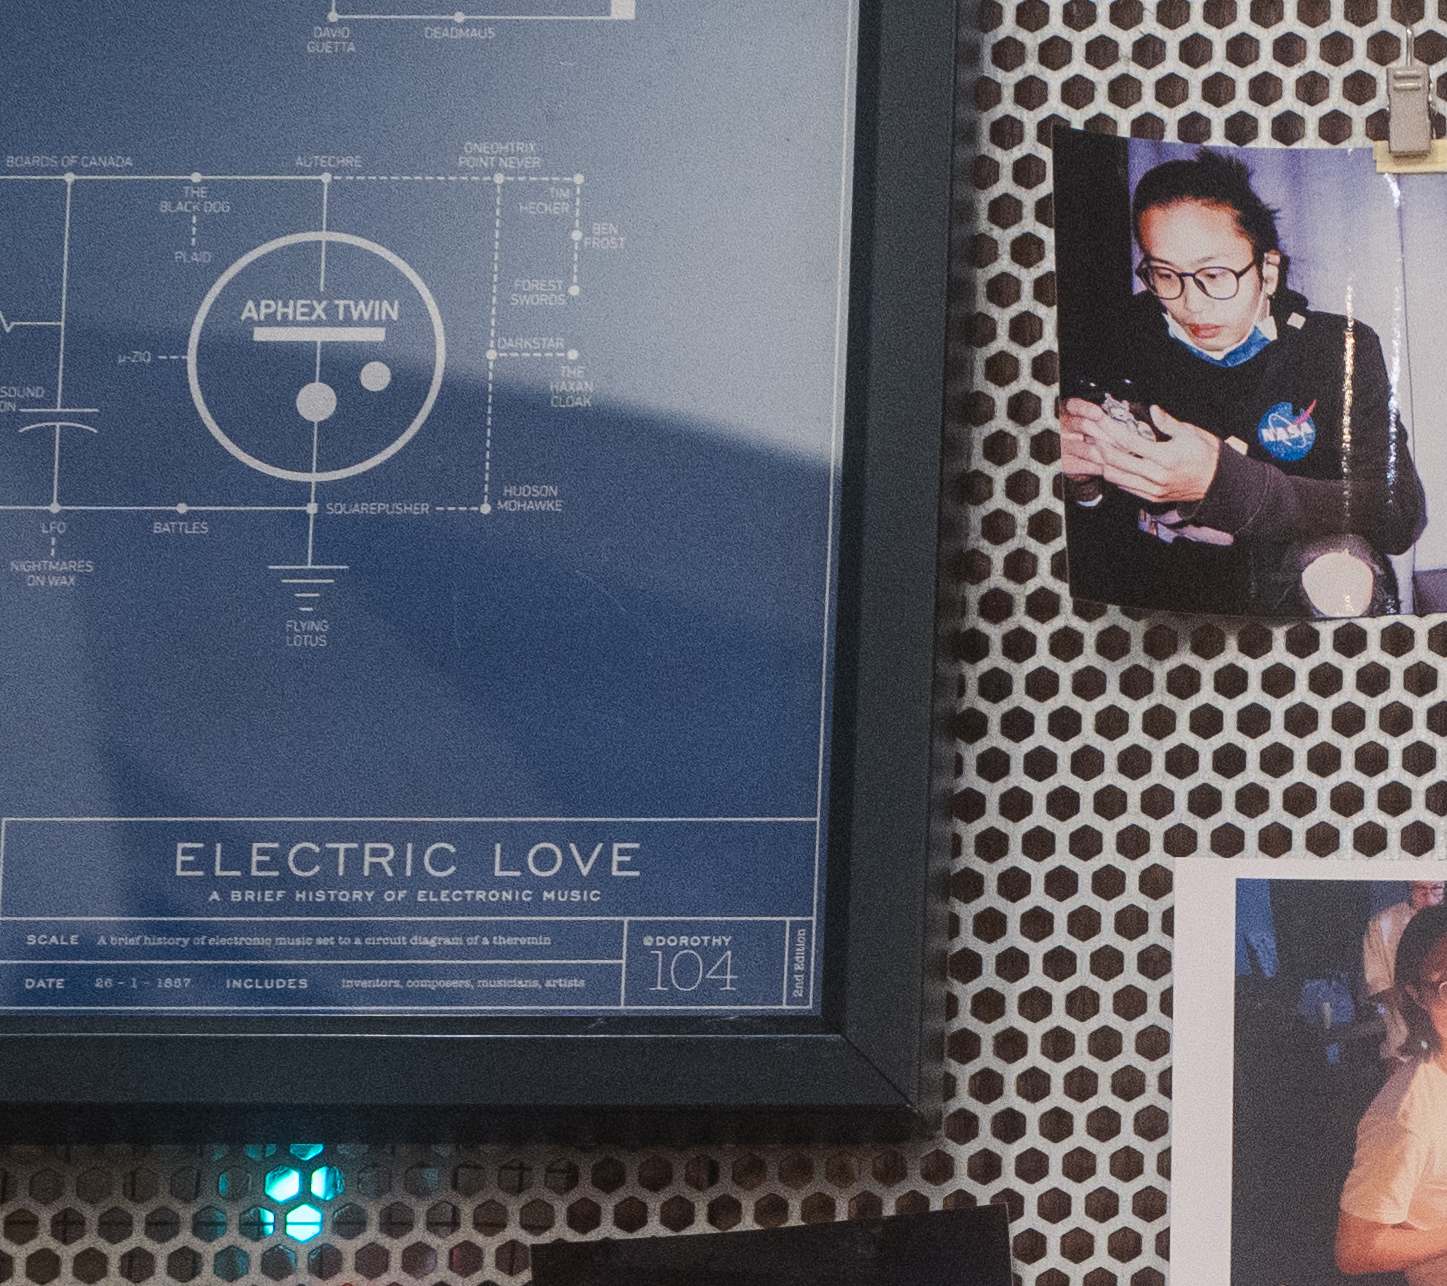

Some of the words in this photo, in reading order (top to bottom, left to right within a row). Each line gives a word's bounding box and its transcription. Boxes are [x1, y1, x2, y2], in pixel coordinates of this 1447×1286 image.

[313, 26, 350, 39] DAVID
[307, 41, 356, 53] GUETTA
[6, 156, 58, 168] BOARDS
[61, 156, 79, 168] OF
[81, 156, 133, 168] CANADA
[295, 156, 362, 168] AUTECHRE
[458, 156, 496, 168] POINT
[499, 156, 541, 168] NEVER
[183, 187, 207, 198] THE
[159, 201, 201, 213] BLACK
[204, 201, 231, 213] DOG
[519, 202, 570, 214] HECKER
[584, 237, 626, 249] FROST
[174, 252, 211, 264] PLAID
[514, 279, 563, 291] FOREST
[241, 300, 328, 323] APHEX
[335, 301, 399, 323] TWIN
[497, 337, 565, 349] DARKSTAR
[560, 365, 586, 377] THE
[0, 386, 45, 398] SOUND
[503, 485, 558, 498] HUDSON
[326, 502, 430, 516] SQUAREPUSHER
[497, 500, 563, 513] MOHAWKE
[42, 522, 66, 534] LFO
[153, 522, 209, 535] BATTLES
[10, 560, 94, 573] NIGHTMARES
[26, 575, 45, 588] ON
[47, 575, 76, 588] WAX
[286, 620, 329, 633] FLYING
[286, 635, 327, 648] LOTUS
[175, 842, 458, 878] ELECTRIC
[493, 842, 641, 878] LOVE
[208, 889, 221, 902] A
[230, 889, 287, 902] BRIEF
[293, 889, 376, 902] HISTORY
[383, 889, 409, 902] OF
[416, 889, 533, 902] ELECTRONIC
[541, 889, 601, 902] MUSIC
[26, 935, 79, 945] SCALE
[97, 936, 107, 946] A
[110, 935, 141, 946] brief
[143, 935, 190, 948] history
[193, 935, 206, 946] of
[208, 935, 272, 946] electronic
[276, 936, 313, 946] music
[316, 936, 335, 946] set
[338, 936, 351, 946] to
[365, 935, 407, 946] circuit
[410, 935, 463, 948] diagram
[466, 935, 480, 947] of
[493, 935, 551, 946] theremin
[795, 929, 806, 974] Edition
[649, 950, 738, 991] 104
[25, 978, 64, 989] DATE
[226, 978, 308, 989] INCLUDES
[793, 978, 803, 997] 2nd
